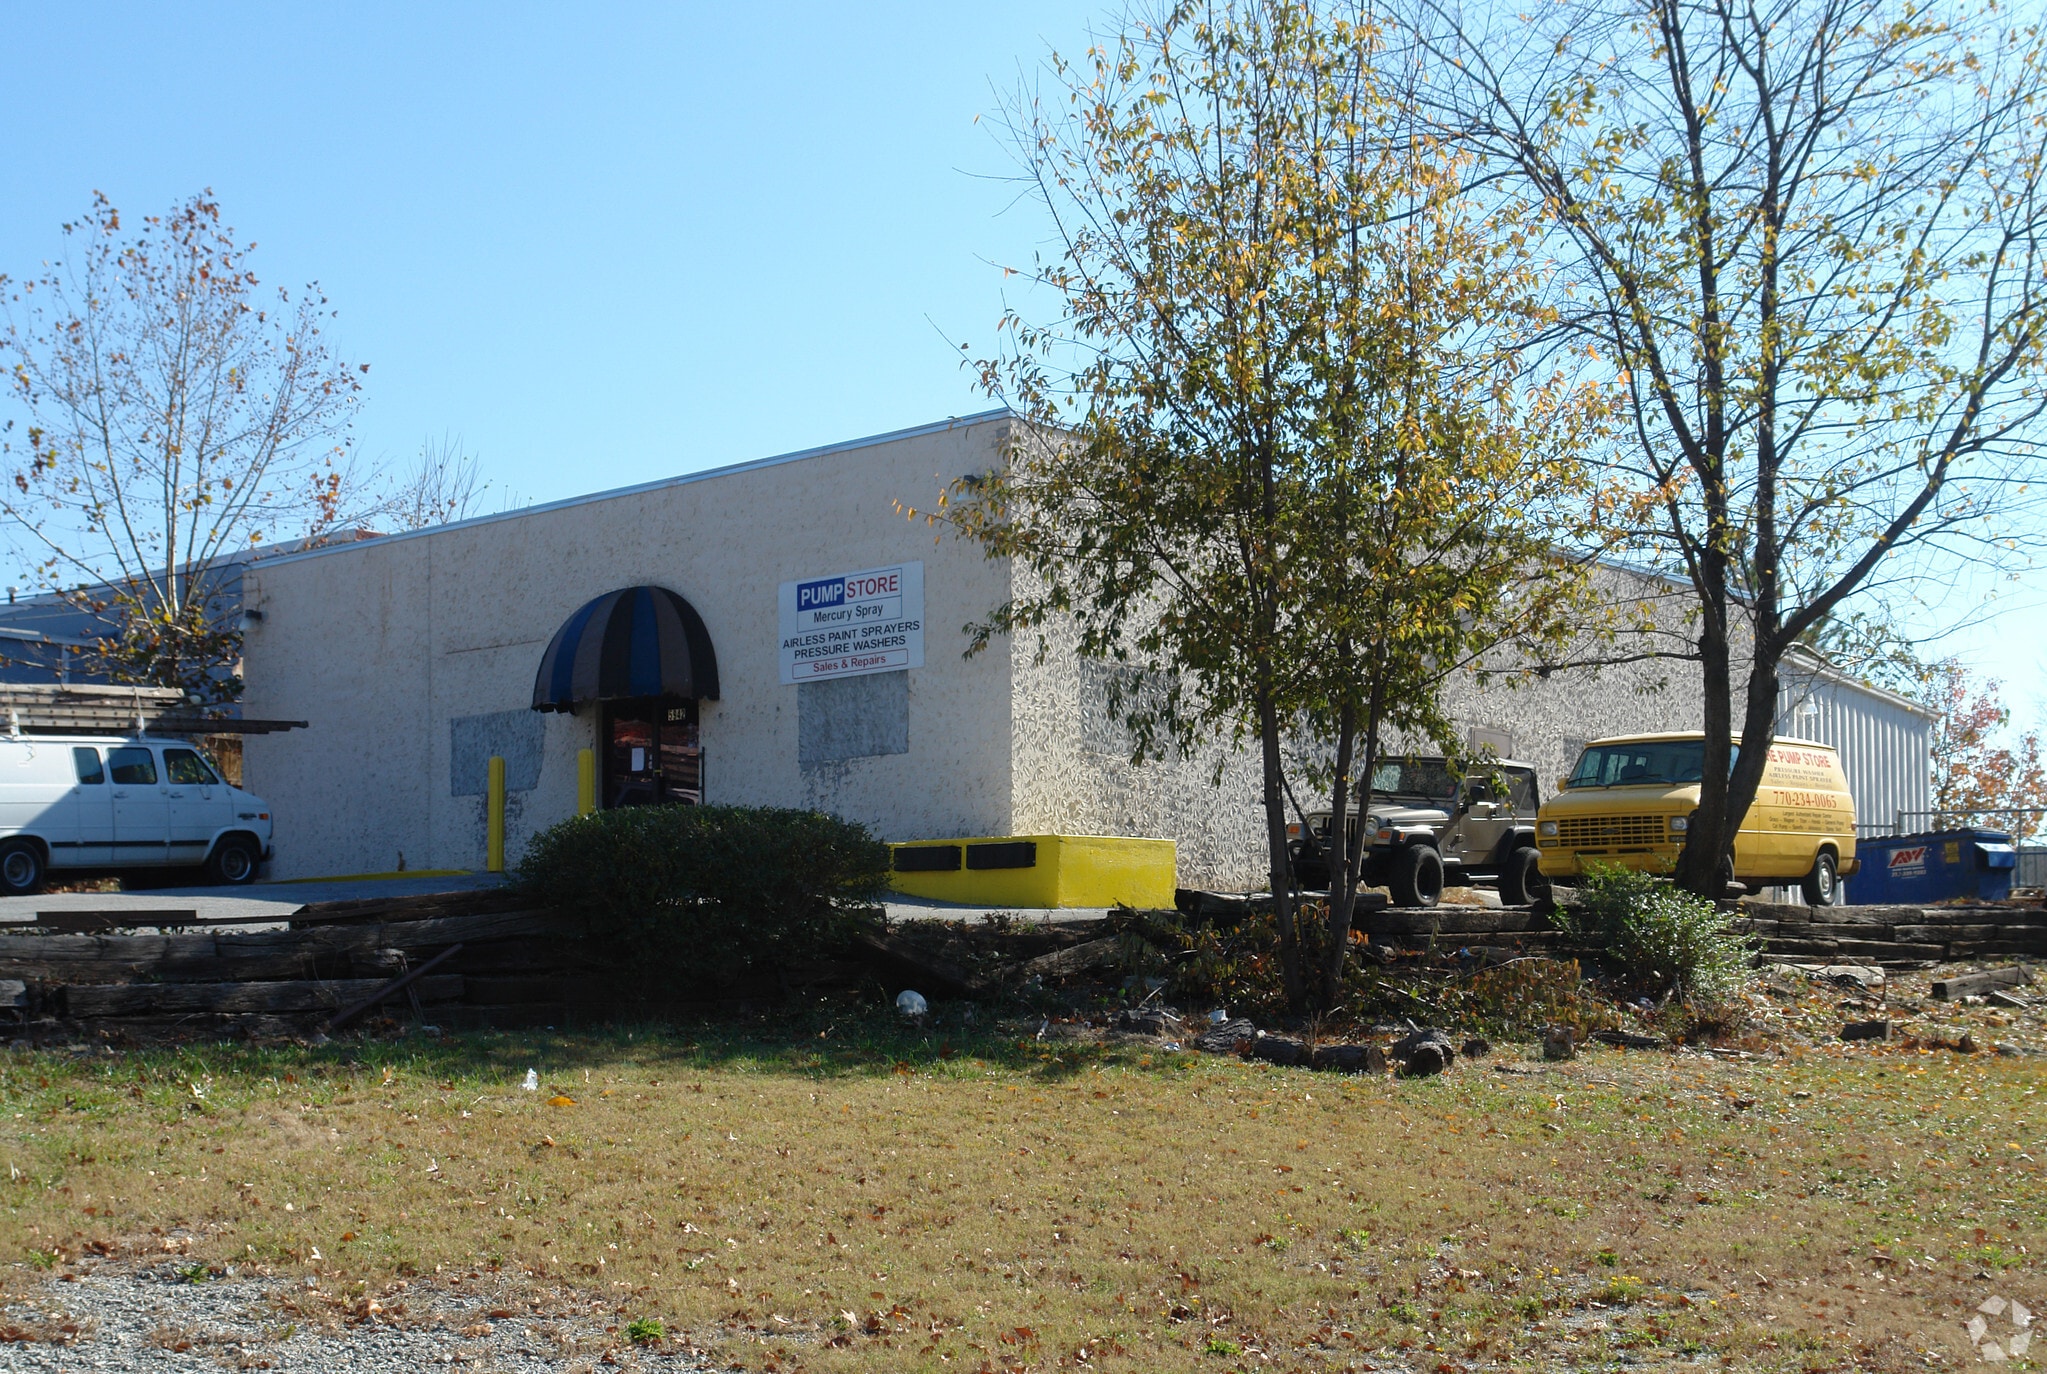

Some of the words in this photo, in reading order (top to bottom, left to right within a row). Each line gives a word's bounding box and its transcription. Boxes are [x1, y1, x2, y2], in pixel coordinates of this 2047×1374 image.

[801, 583, 843, 606] PUMP
[846, 574, 898, 598] STORE
[814, 609, 852, 623] Mercury
[855, 604, 883, 619] Spray
[783, 633, 826, 649] AIRLESS
[828, 629, 858, 645] PAINT
[861, 620, 920, 637] SPRAYERS
[794, 642, 849, 659] PRESSURE
[853, 635, 906, 651] WASHERS
[813, 661, 838, 673] Sales
[841, 659, 848, 668] &
[851, 654, 886, 668] Repairs
[1777, 750, 1801, 764] PUMP
[1802, 752, 1831, 768] STORE
[1774, 766, 1801, 774] PRESSURE
[1773, 791, 1836, 808] 770-234-0065
